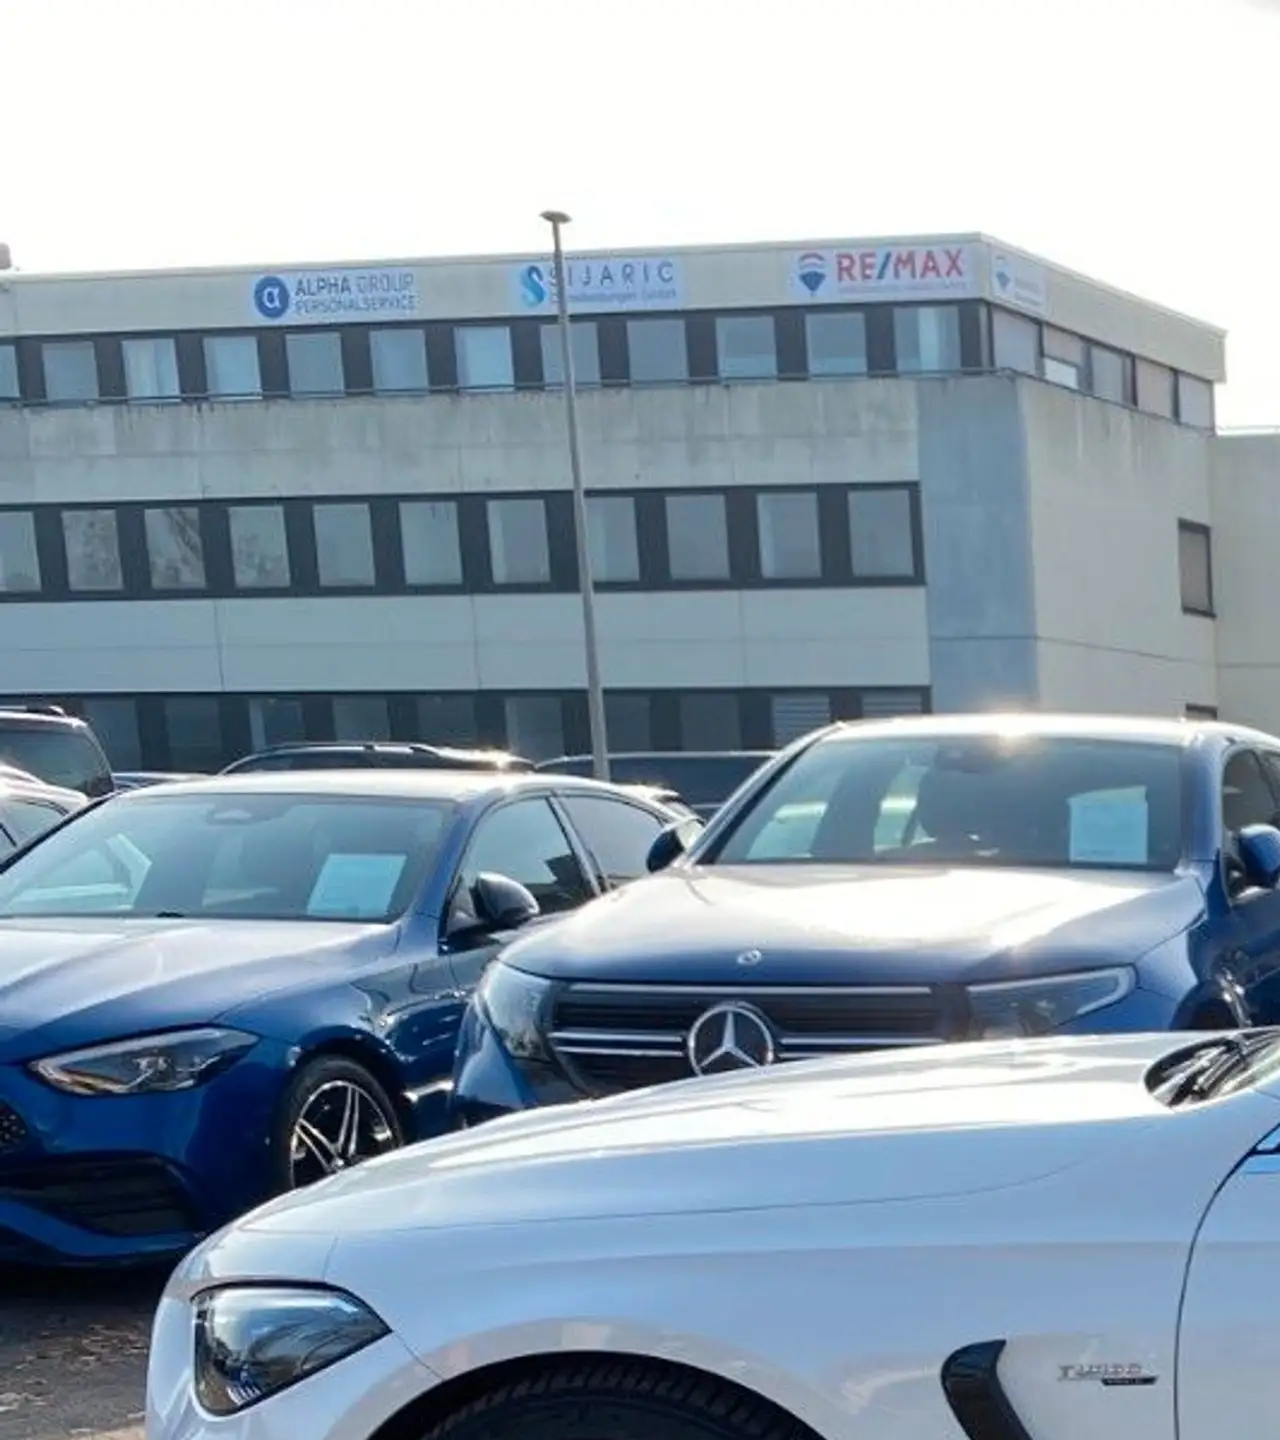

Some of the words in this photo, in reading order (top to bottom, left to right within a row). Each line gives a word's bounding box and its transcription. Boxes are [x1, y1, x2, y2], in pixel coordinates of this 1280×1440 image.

[836, 249, 965, 283] RE/MAX
[295, 275, 352, 296] ALPHA
[356, 272, 414, 294] GROUP
